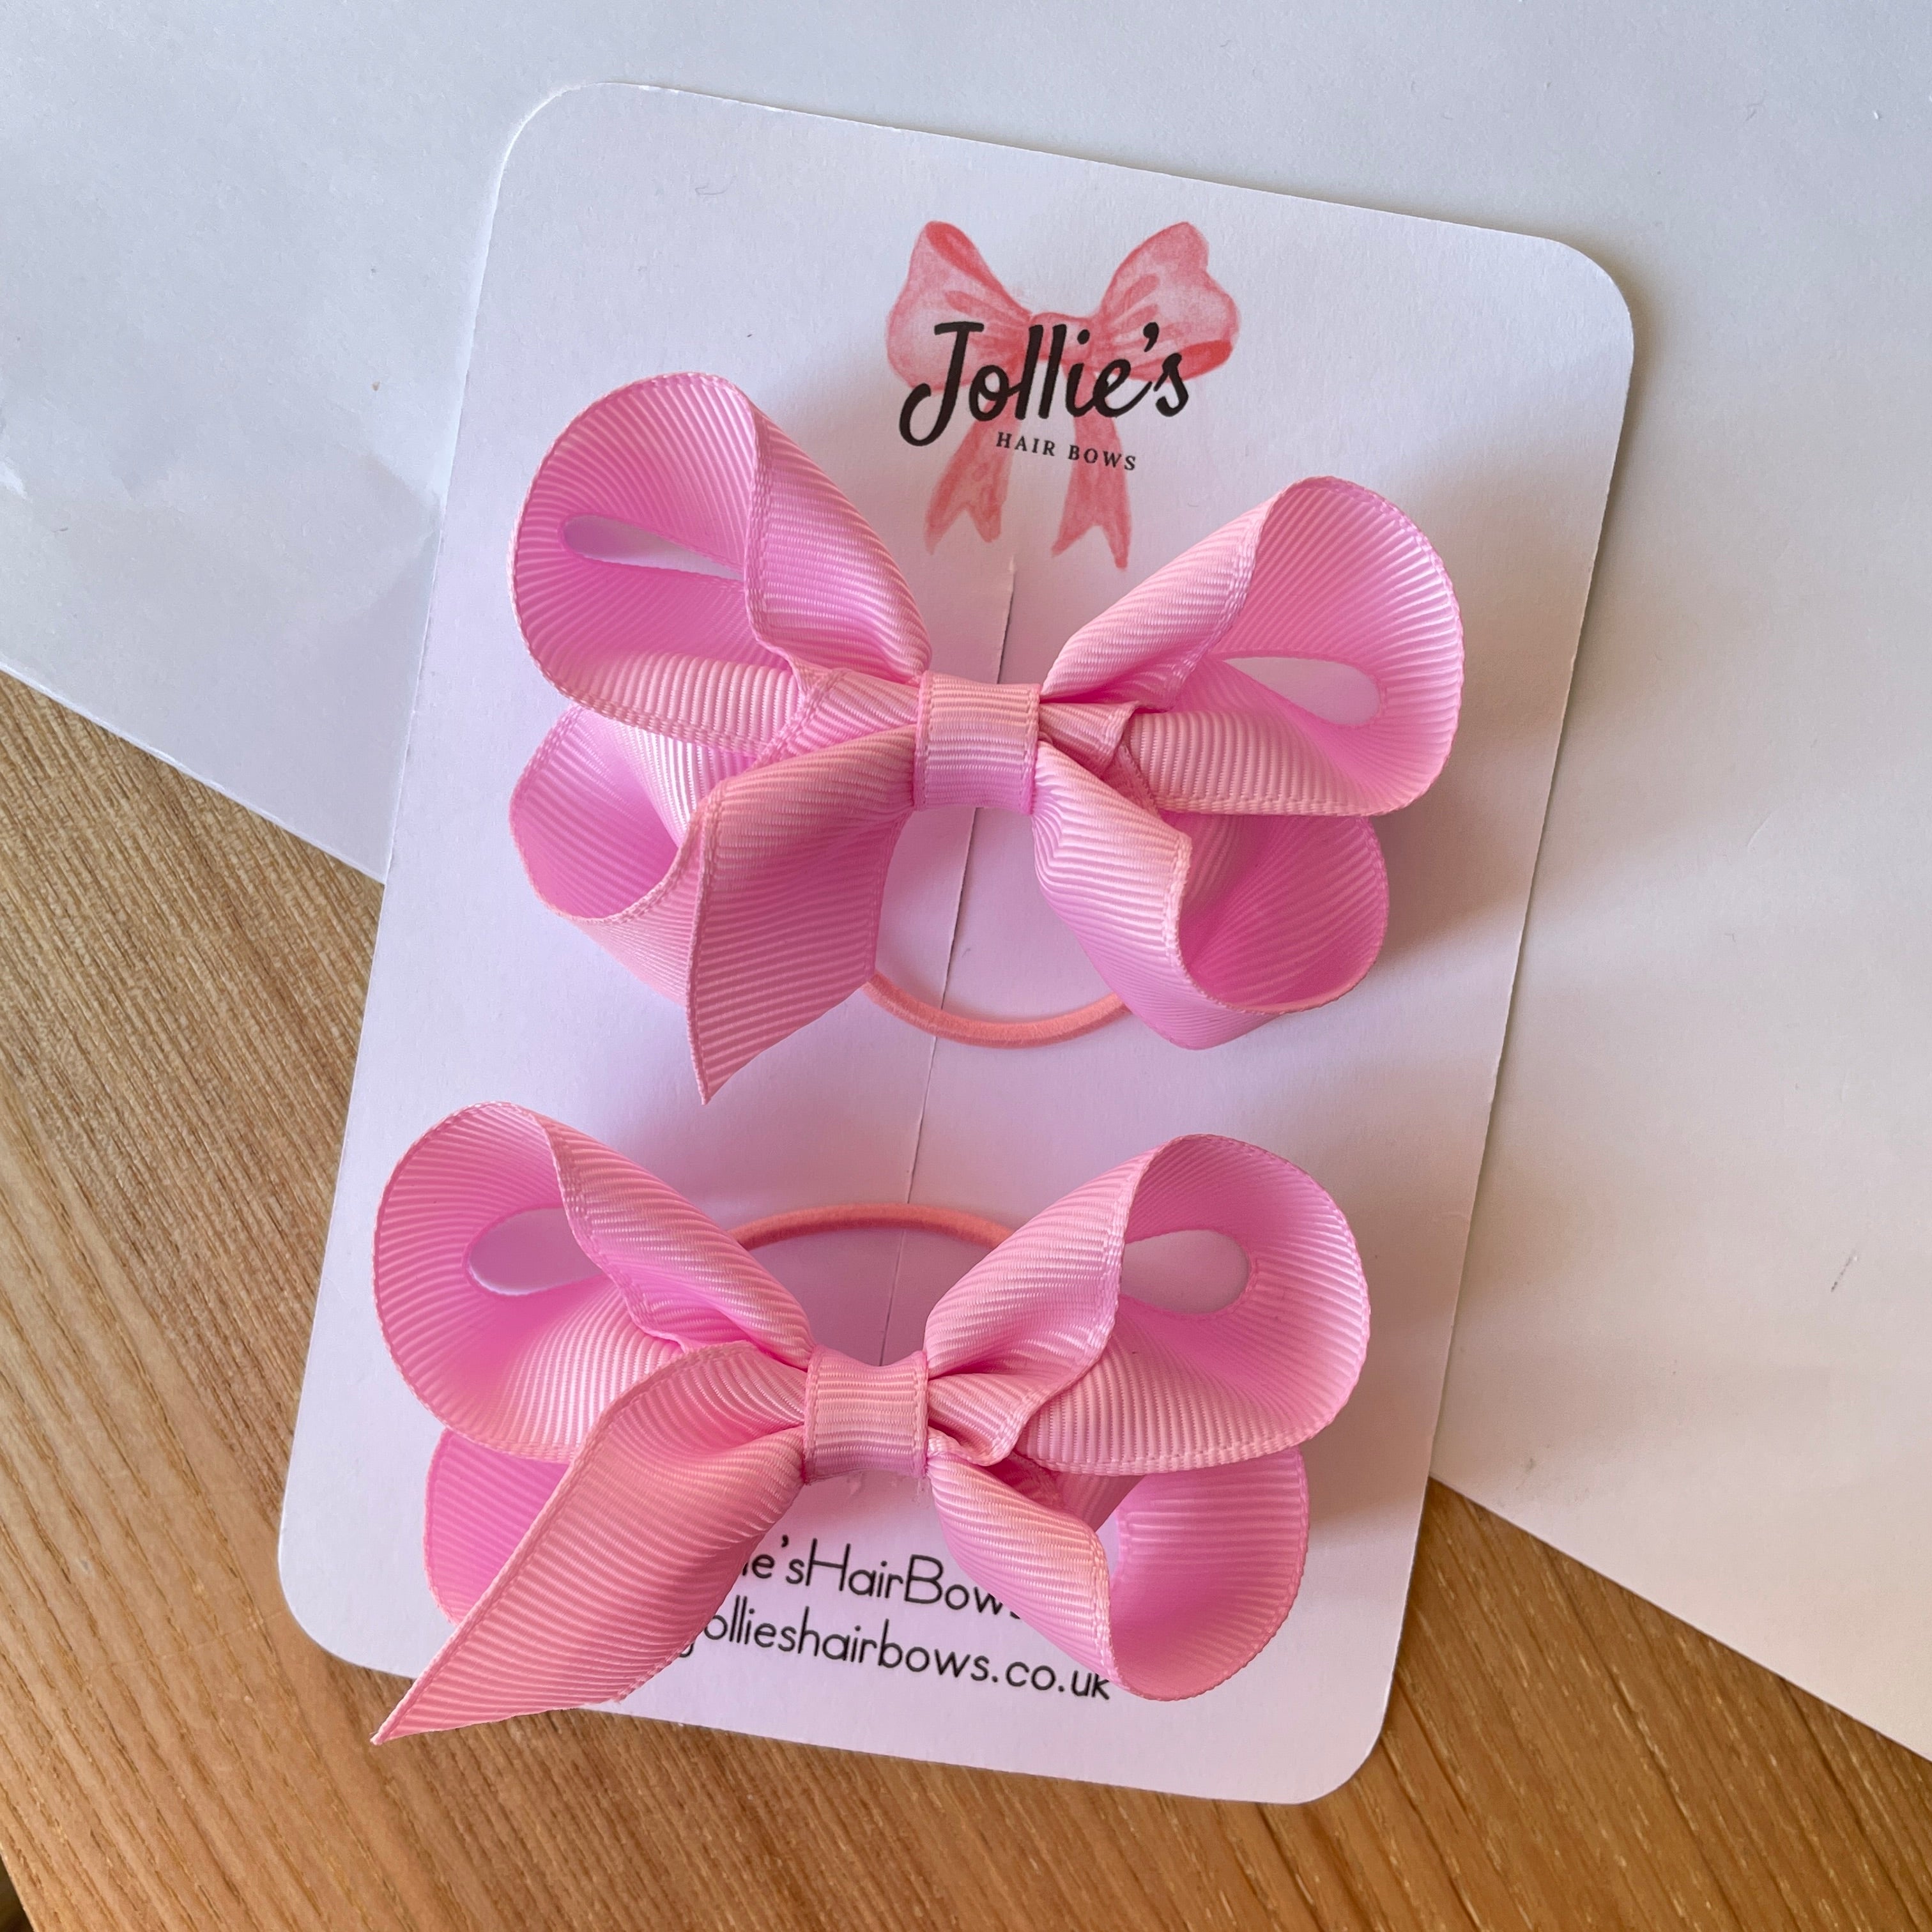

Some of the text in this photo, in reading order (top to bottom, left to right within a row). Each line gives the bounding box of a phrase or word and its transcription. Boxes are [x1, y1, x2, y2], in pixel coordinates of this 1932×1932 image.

[899, 321, 1189, 447] Jollie's
[995, 431, 1137, 471] HAIR BOWS
[742, 1535, 1021, 1620] e'sHairBow
